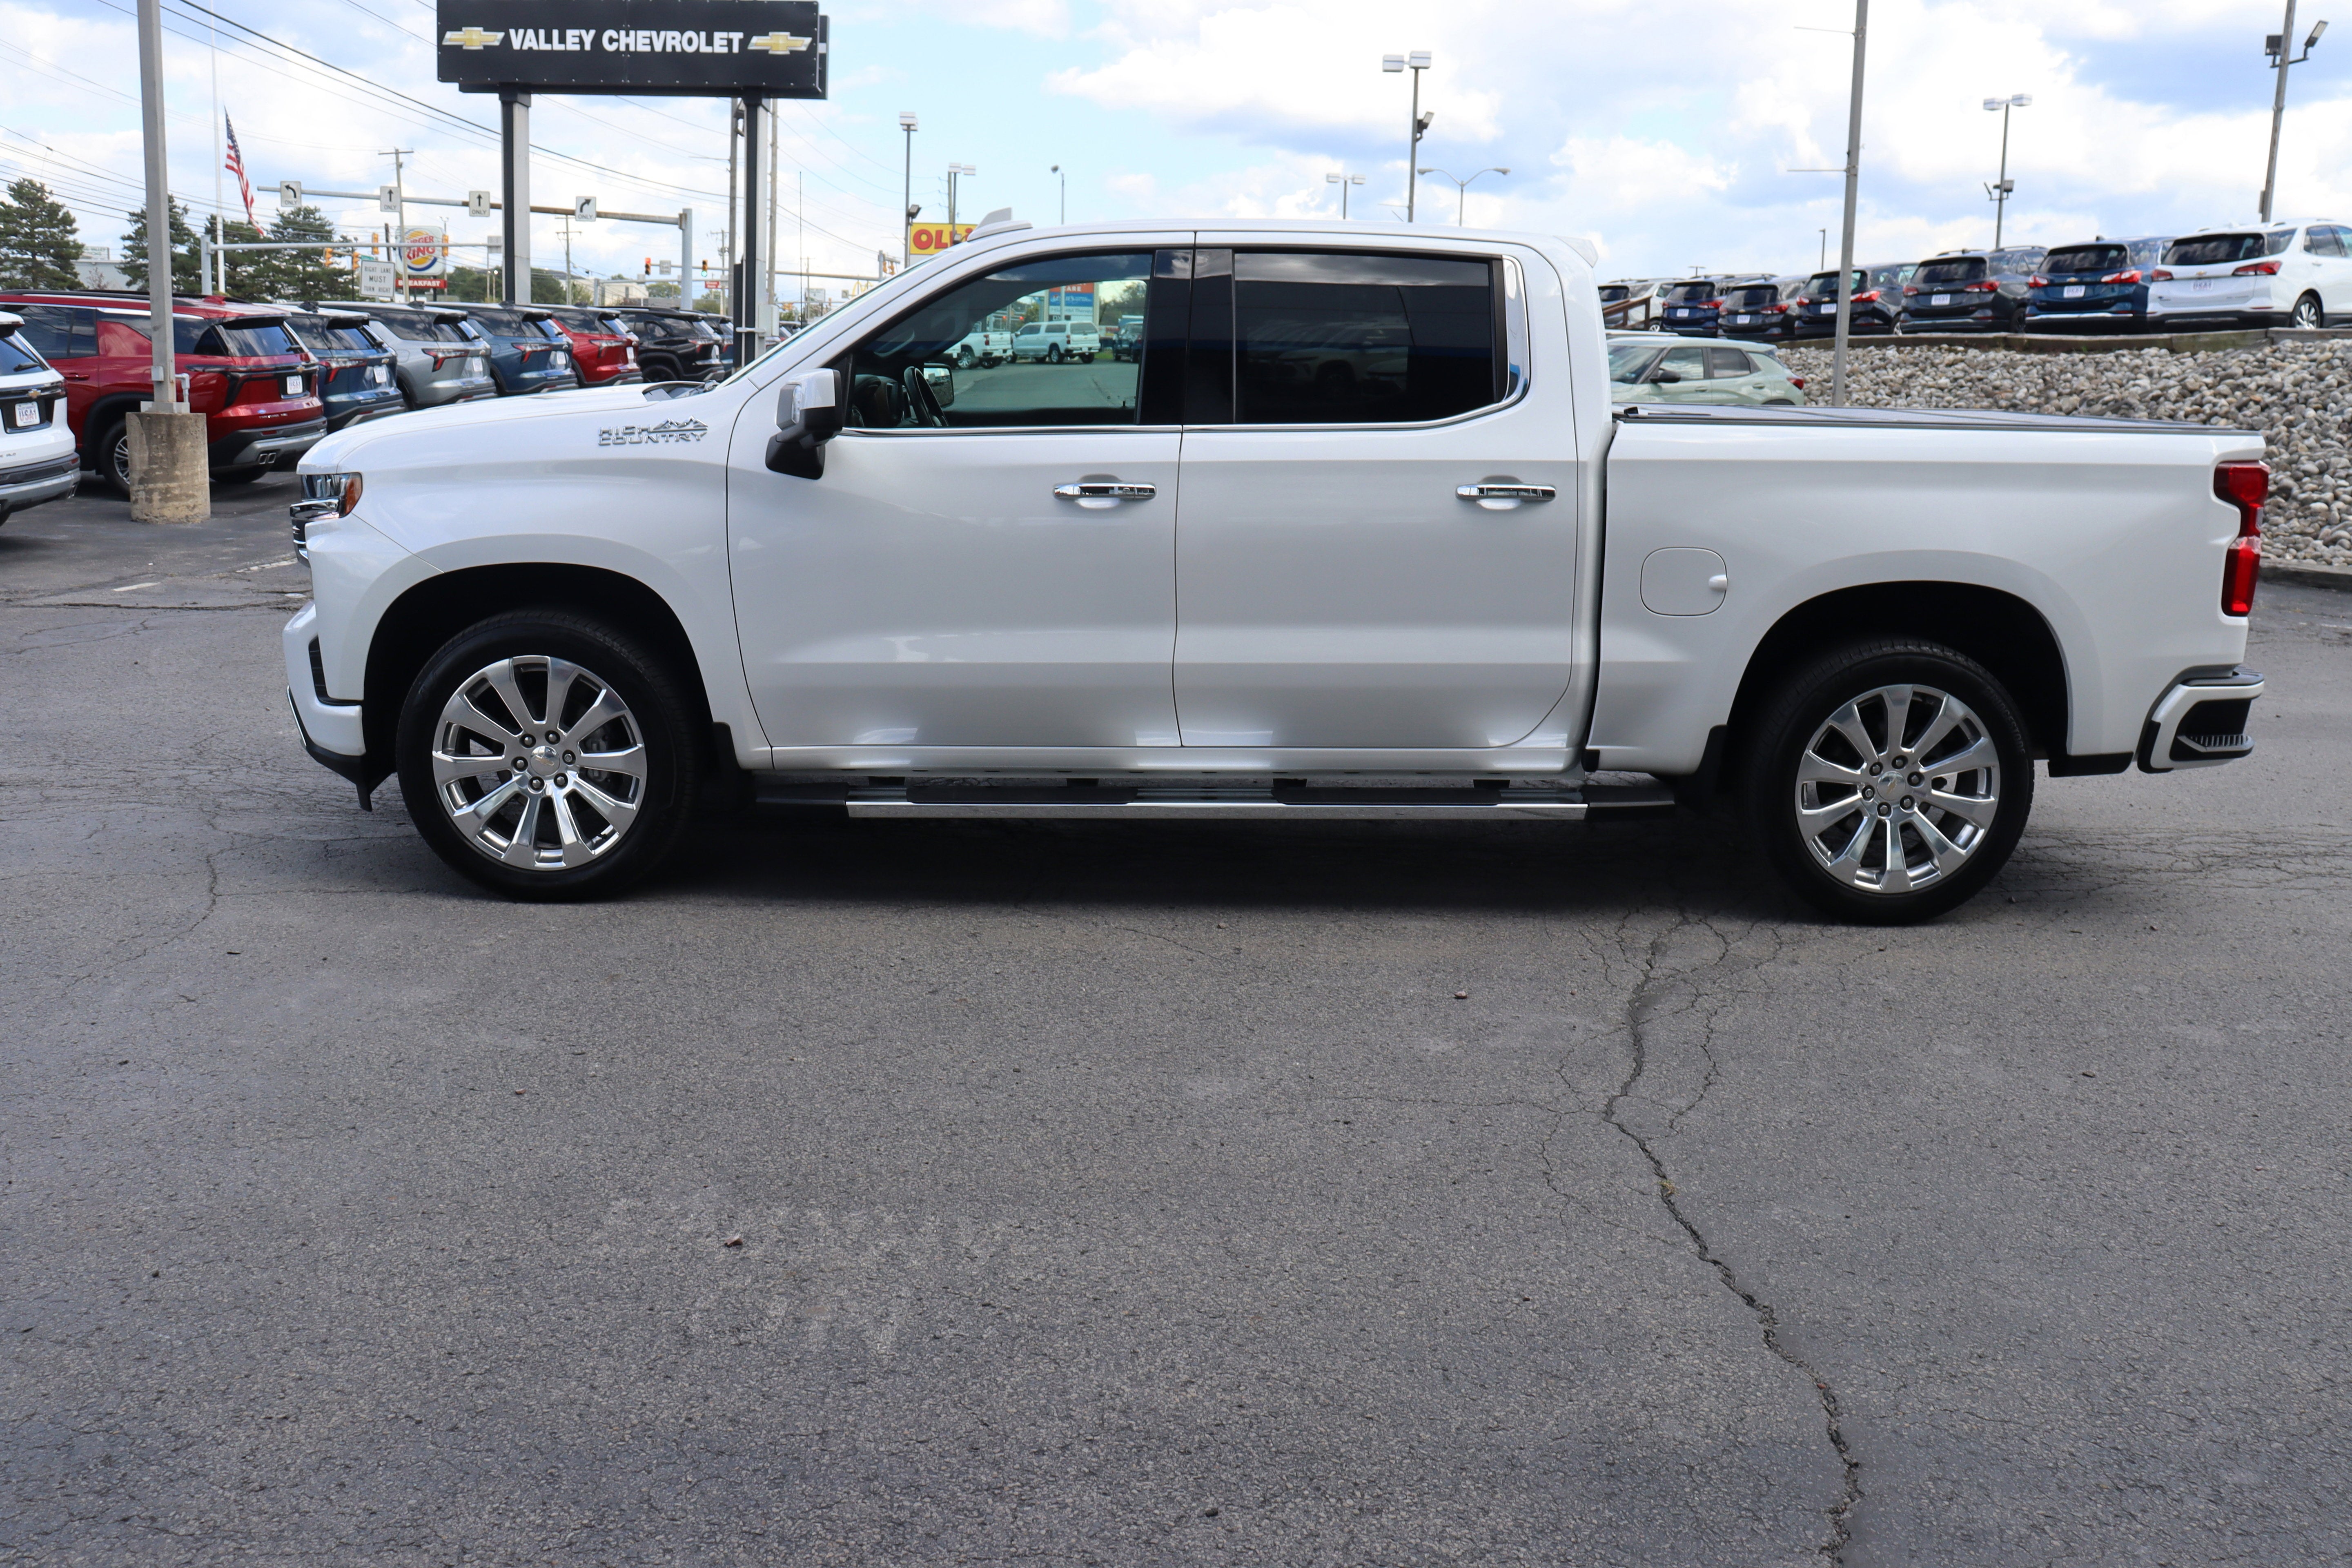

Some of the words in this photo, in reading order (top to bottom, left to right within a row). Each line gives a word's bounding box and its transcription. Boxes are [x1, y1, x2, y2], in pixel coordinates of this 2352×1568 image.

[508, 28, 596, 51] VALLEY
[602, 29, 744, 54] CHEVROLET
[369, 275, 386, 283] MUST
[598, 424, 653, 436] HIGH
[598, 431, 708, 445] COUNTRY
